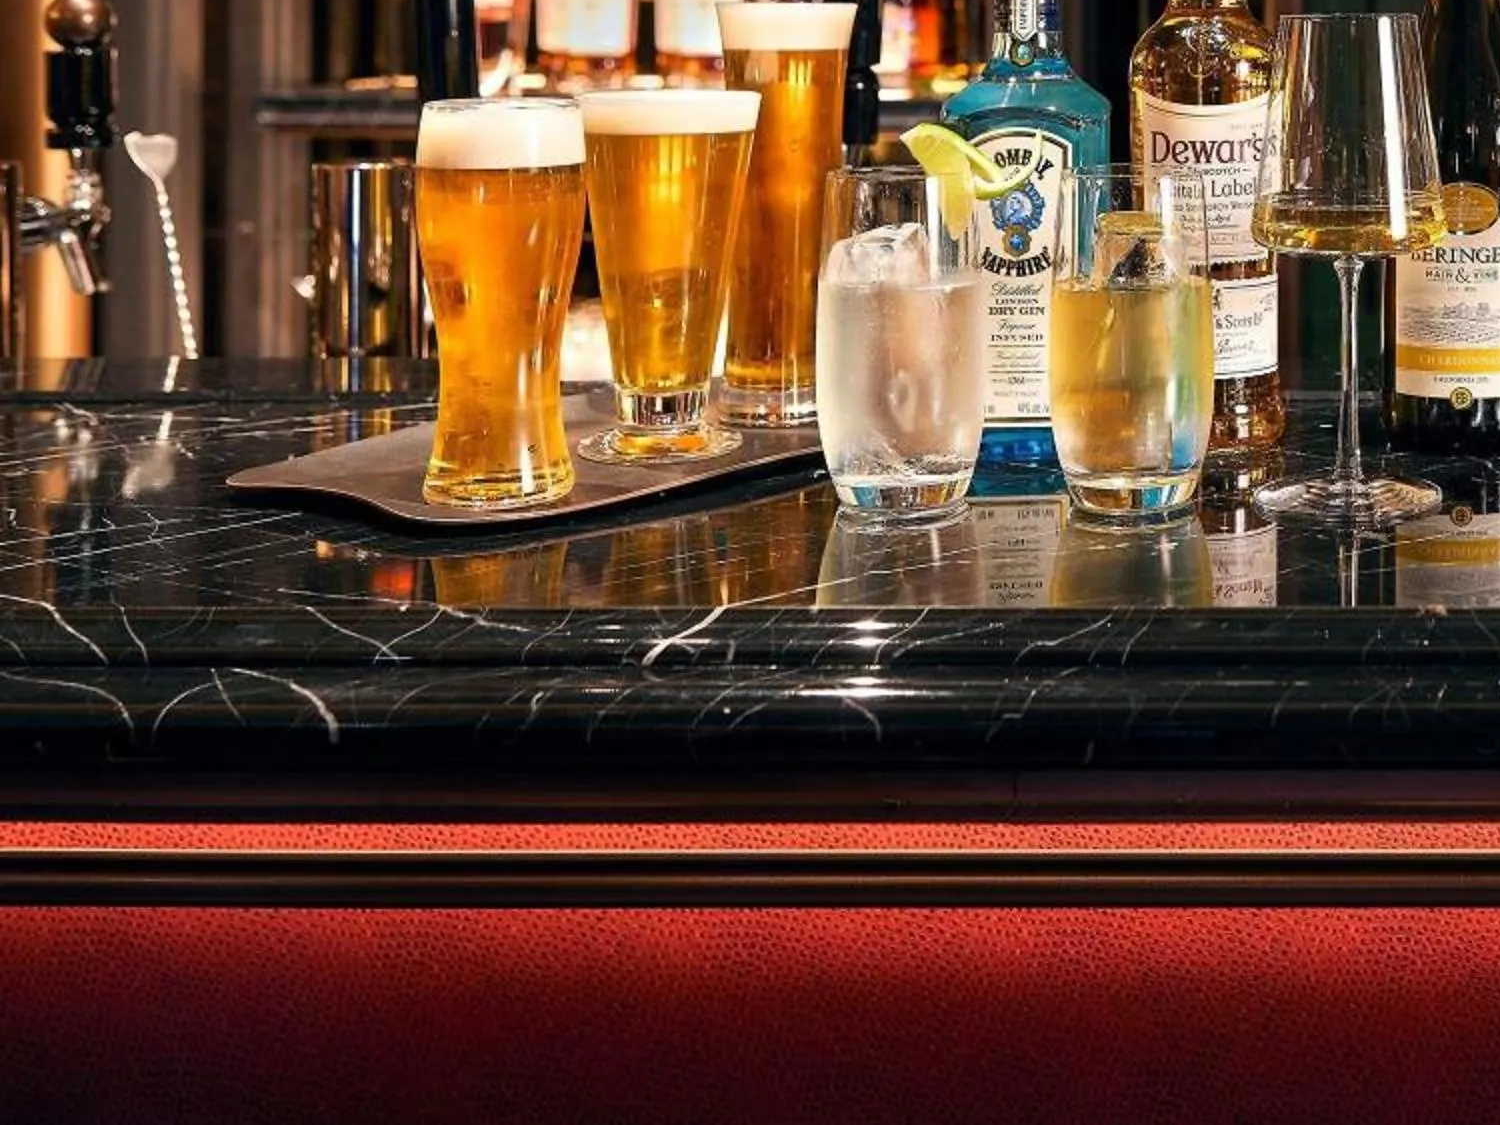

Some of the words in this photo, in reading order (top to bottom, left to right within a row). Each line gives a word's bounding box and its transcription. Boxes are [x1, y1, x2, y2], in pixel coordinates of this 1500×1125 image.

[1151, 130, 1263, 164] Dewar's
[993, 147, 1055, 181] OMBY
[1211, 177, 1257, 198] Label
[981, 246, 1052, 277] SAPPHIRE
[987, 306, 1017, 316] DRY
[1019, 306, 1045, 316] GIN
